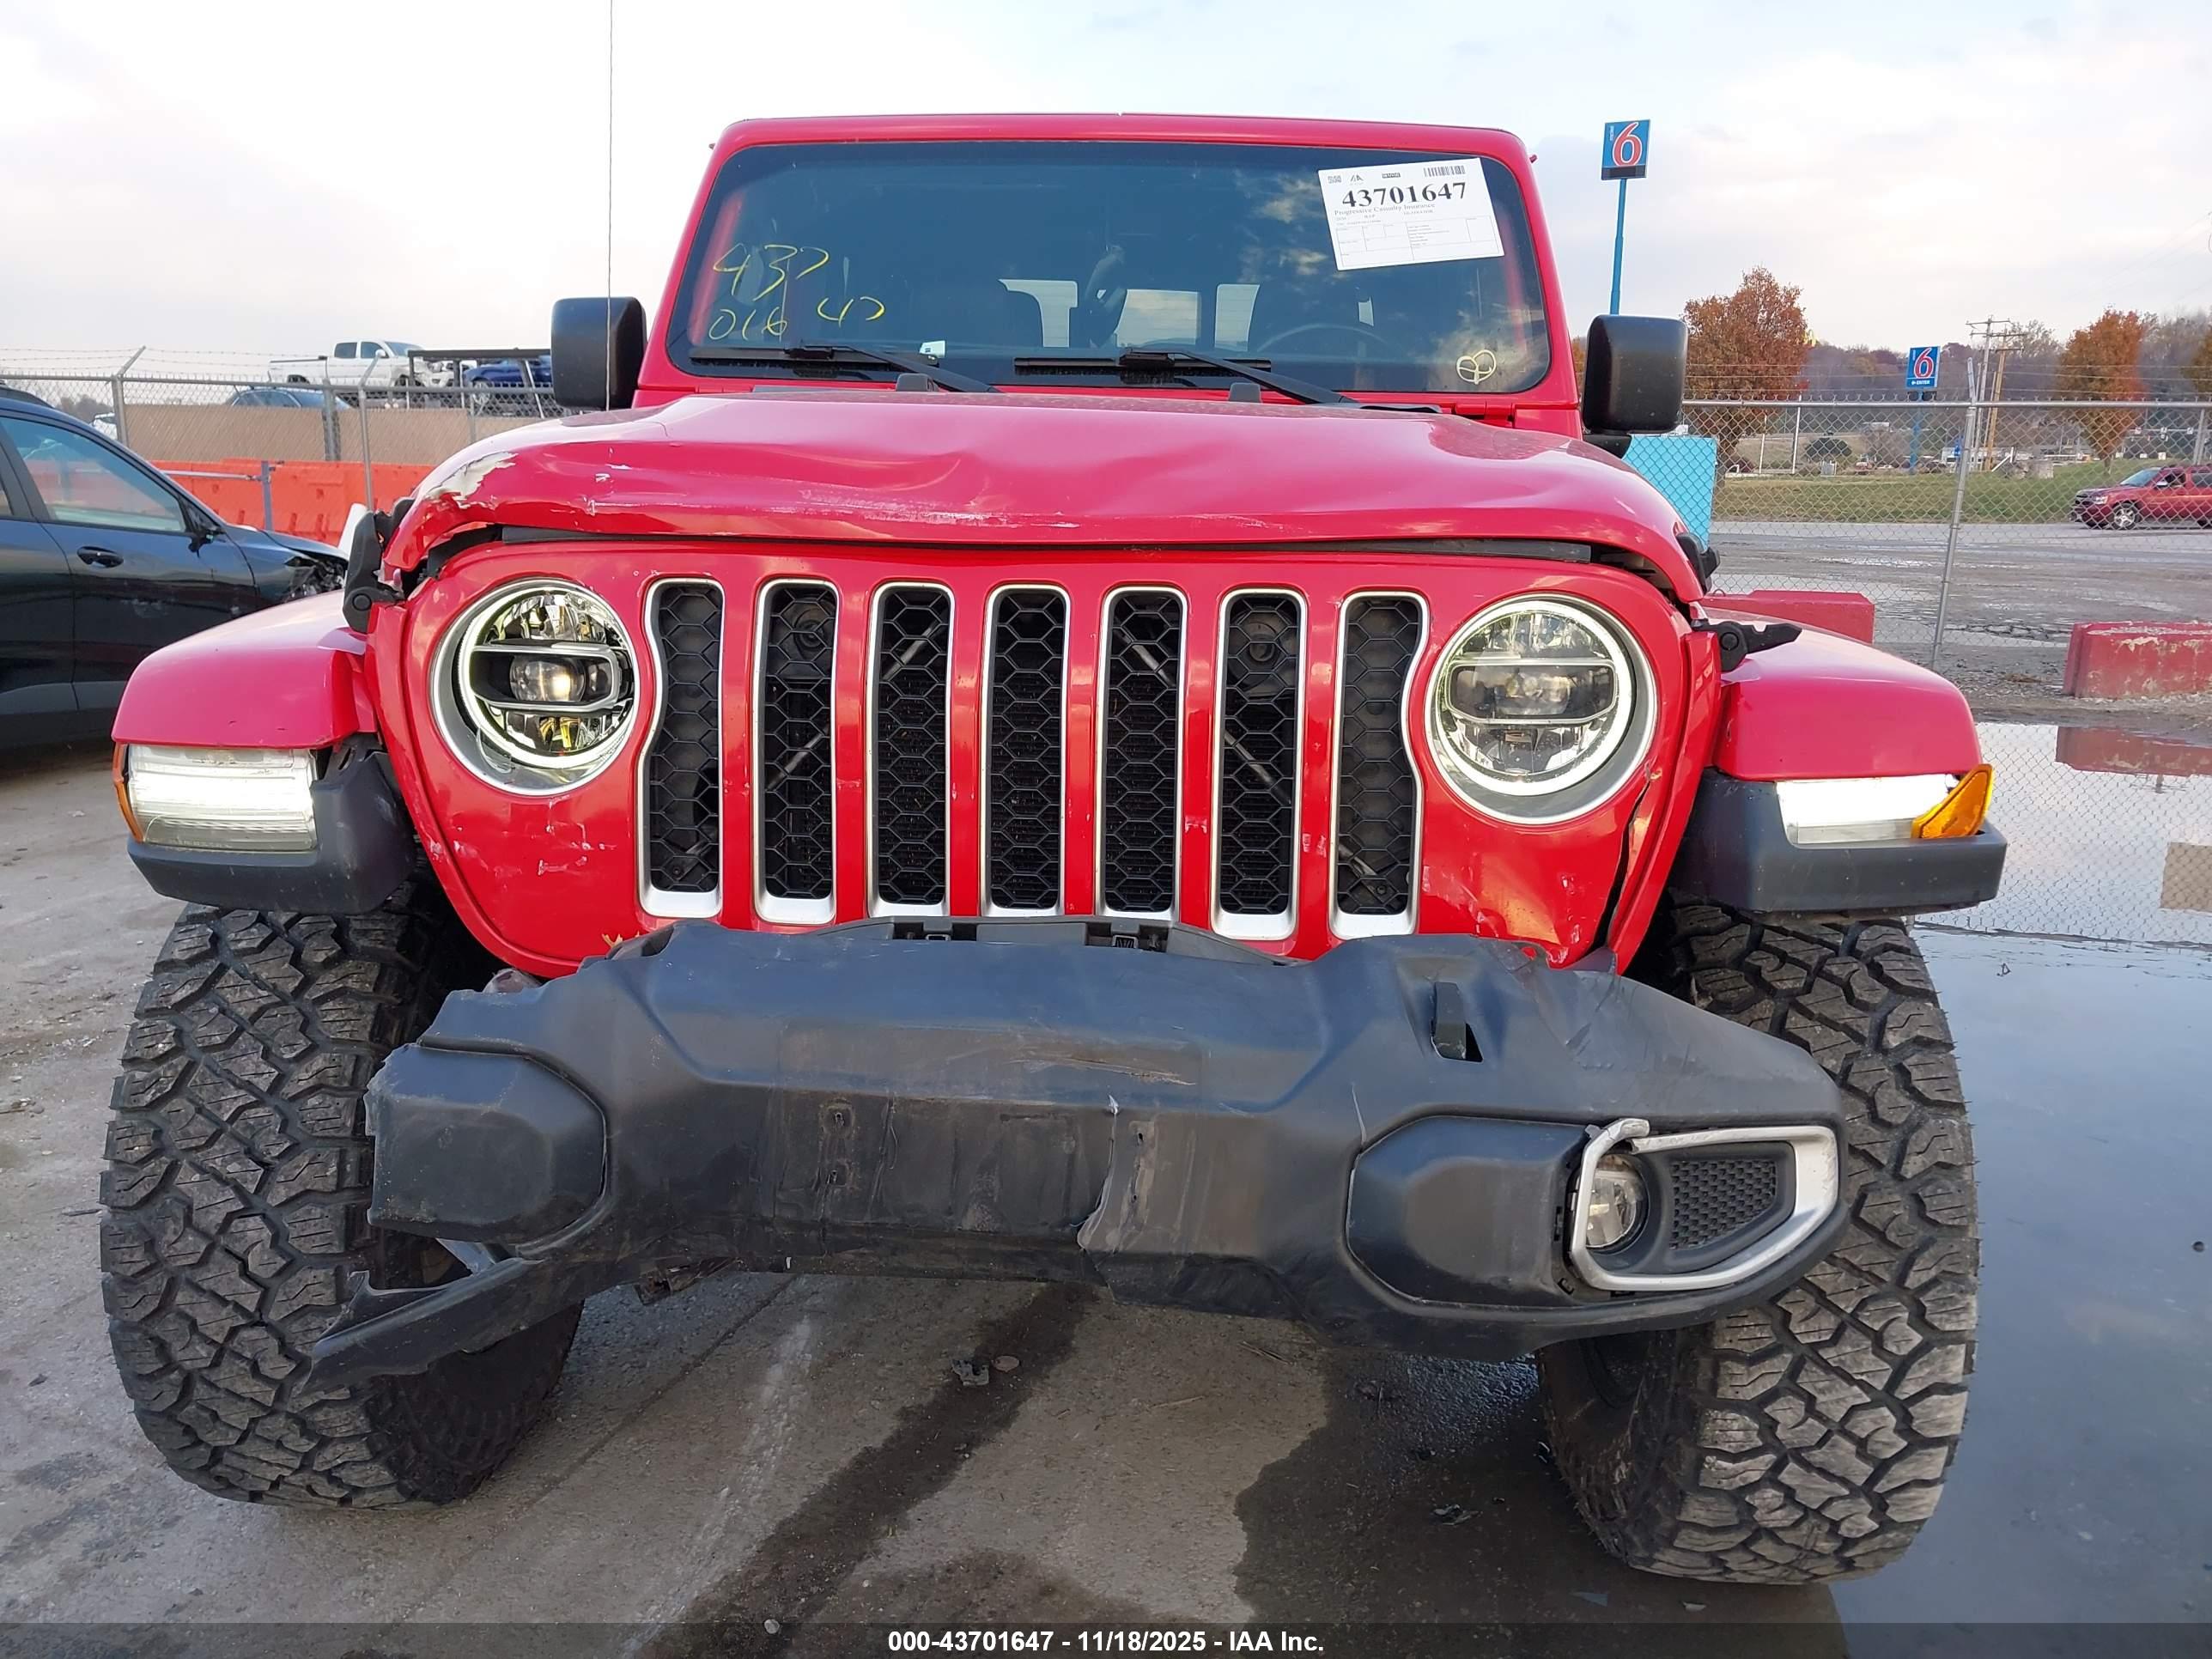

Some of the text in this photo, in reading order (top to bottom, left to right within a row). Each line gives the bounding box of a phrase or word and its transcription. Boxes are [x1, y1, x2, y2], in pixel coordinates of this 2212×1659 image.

[1613, 122, 1642, 166] 6
[1342, 181, 1467, 209] 43701647
[1373, 205, 1402, 214] Casualty
[1403, 203, 1436, 211] Insurance
[1914, 348, 1934, 379] 6
